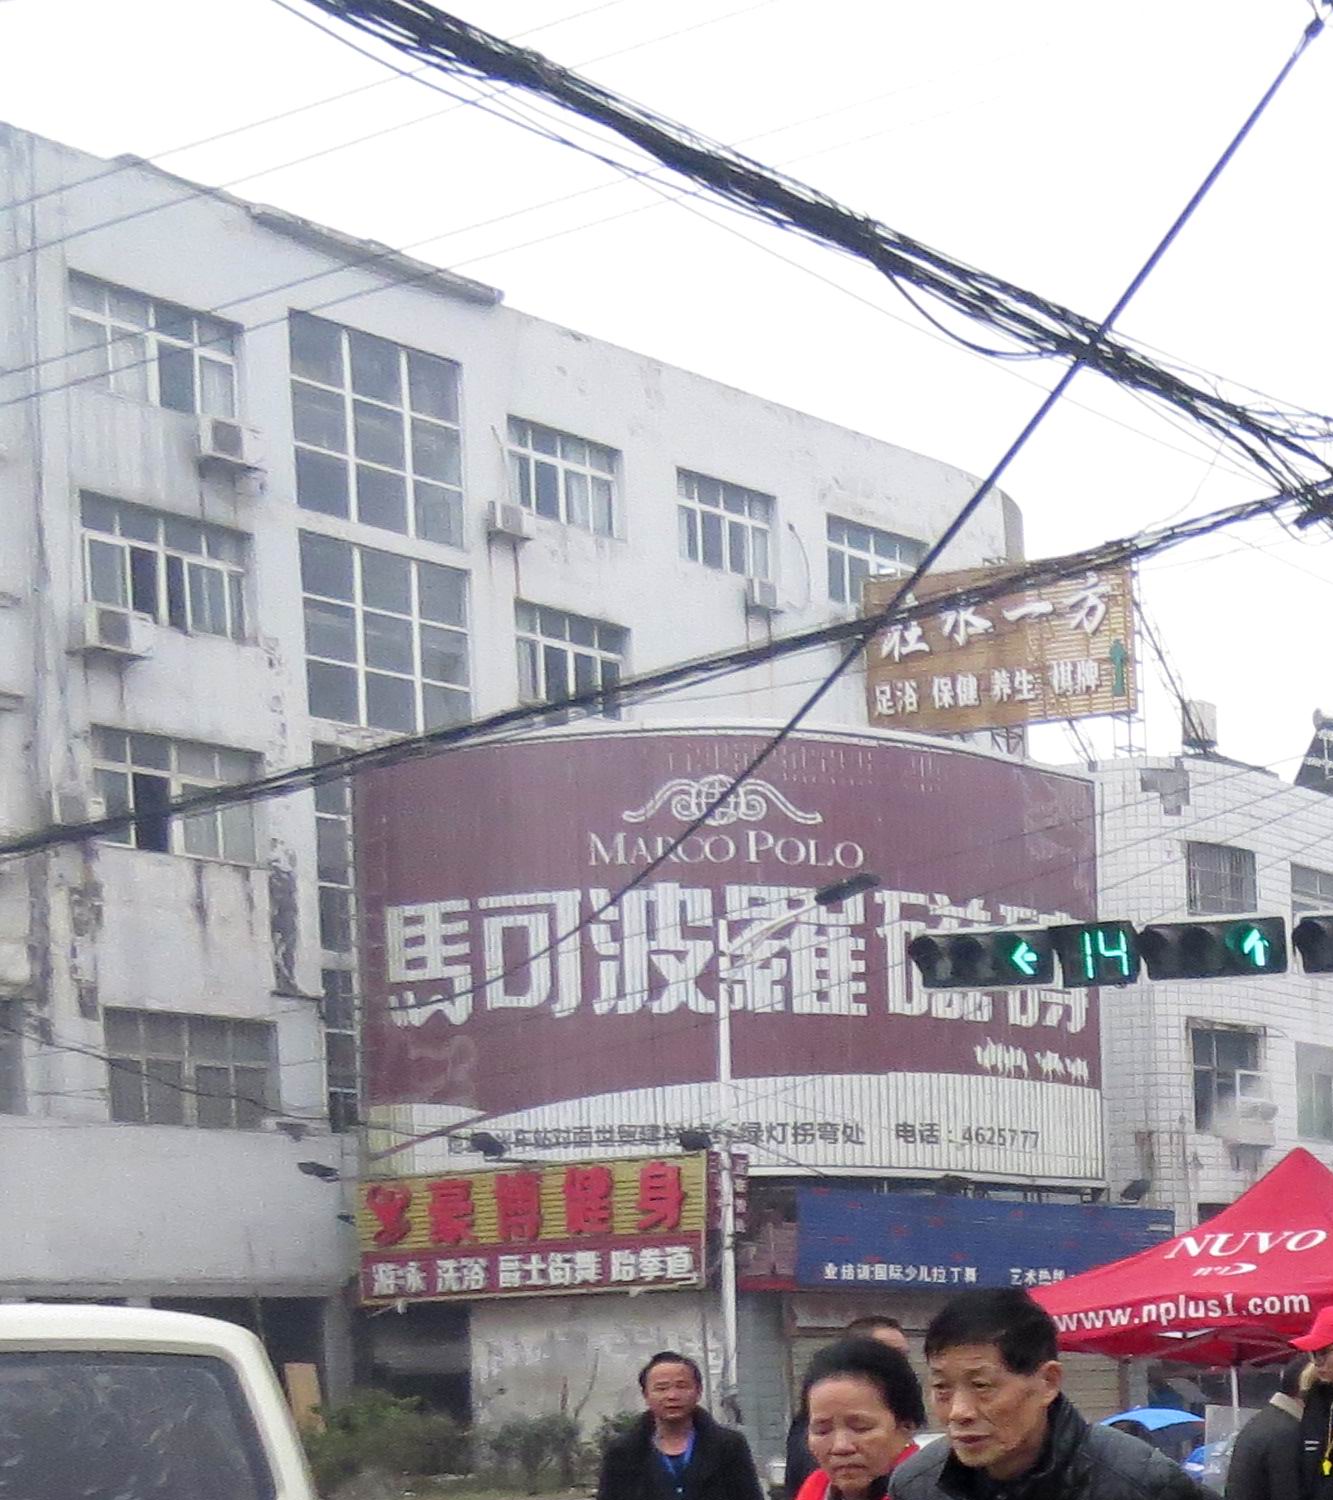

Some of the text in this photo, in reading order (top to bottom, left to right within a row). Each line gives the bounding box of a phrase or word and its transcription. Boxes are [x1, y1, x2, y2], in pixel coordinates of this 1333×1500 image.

[873, 680, 920, 717] 足浴
[931, 672, 980, 709] 保健
[588, 830, 866, 870] MARCO POLO
[1081, 929, 1130, 979] 14
[1164, 1228, 1328, 1260] NUVO
[1055, 1292, 1311, 1333] www.nplus1.com
